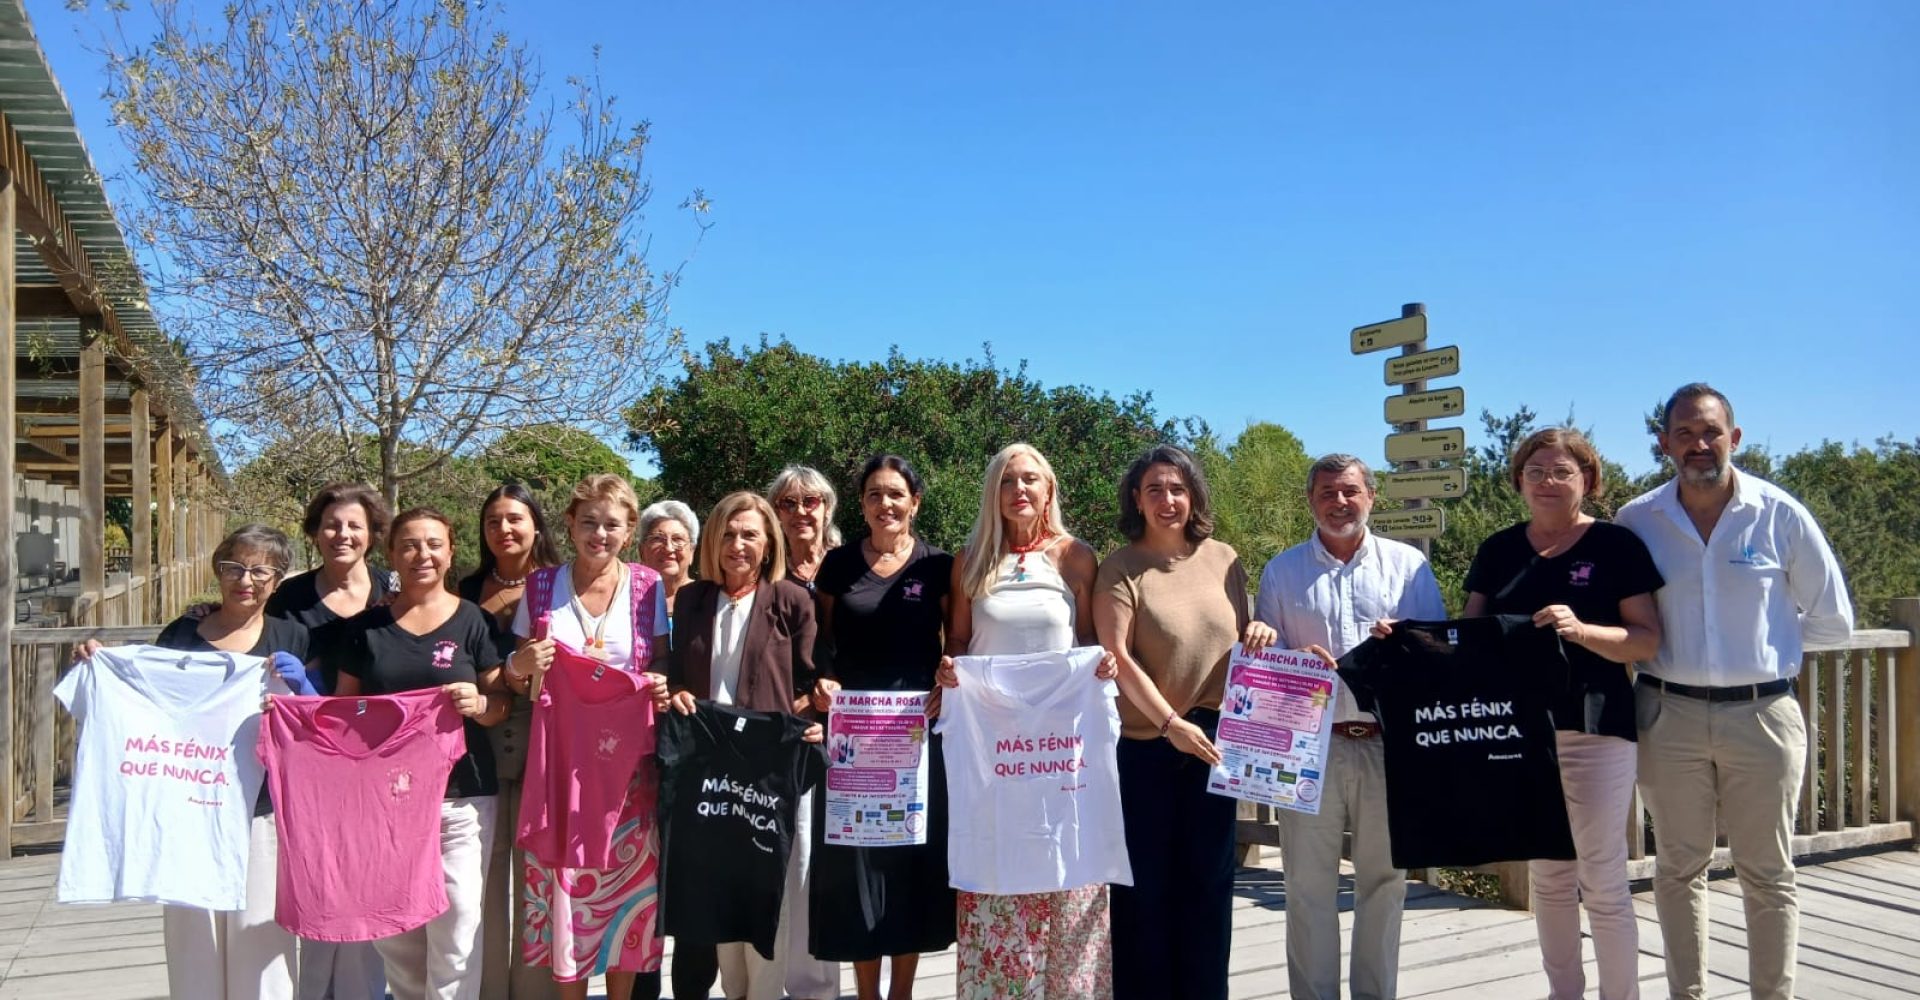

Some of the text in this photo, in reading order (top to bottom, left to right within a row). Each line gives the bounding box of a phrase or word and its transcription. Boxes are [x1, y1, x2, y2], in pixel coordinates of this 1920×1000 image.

[1240, 648, 1250, 659] IX
[1253, 651, 1298, 666] MARCHA
[1302, 658, 1330, 671] ROSA
[836, 695, 922, 707] IX MARCHA ROSA
[1415, 696, 1514, 724] MÁS FÉNIX
[996, 733, 1034, 754] MÁS
[1415, 724, 1523, 748] QUE NUNCA.
[125, 734, 229, 761] MÁS FÉNIX
[119, 760, 230, 787] QUE NUNCA.
[994, 762, 1025, 778] QUE
[701, 773, 739, 794] MÁS
[697, 801, 729, 817] QUE
